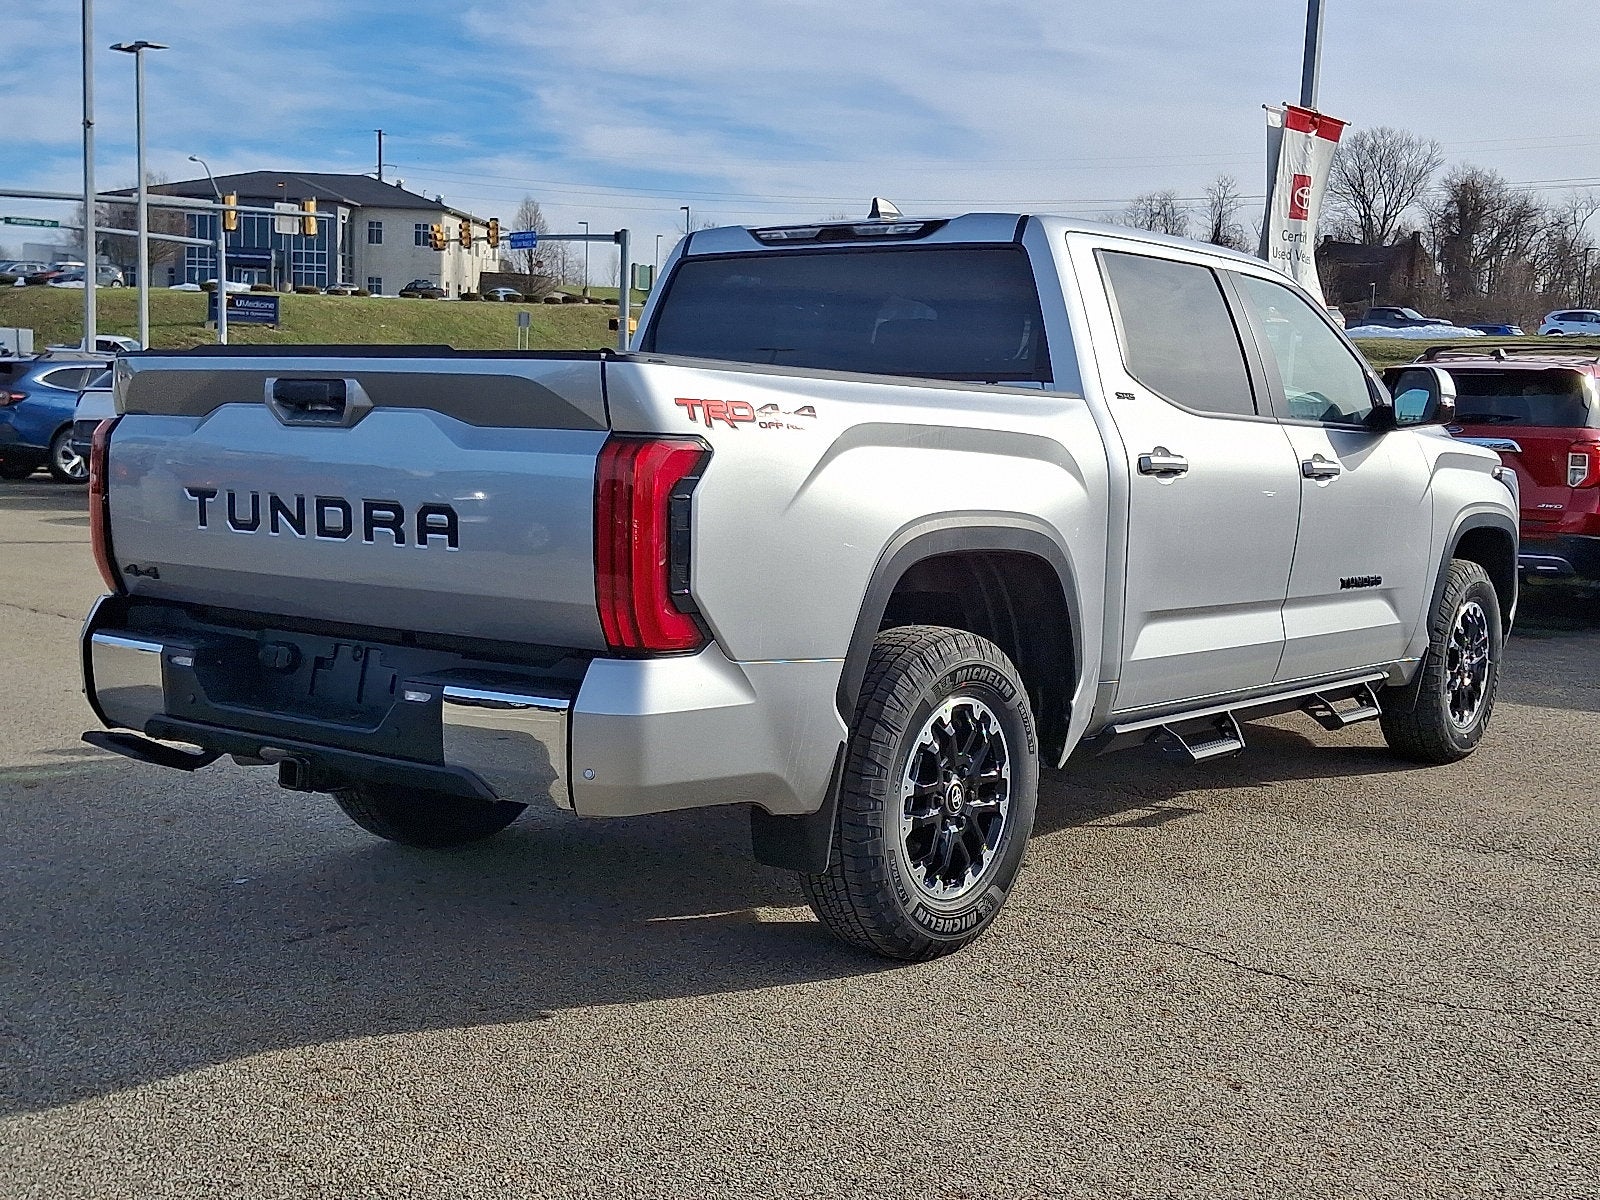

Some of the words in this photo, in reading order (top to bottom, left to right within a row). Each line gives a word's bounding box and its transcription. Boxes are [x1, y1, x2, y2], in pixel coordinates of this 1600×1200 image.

[1272, 246, 1292, 260] Used
[674, 397, 756, 430] TRD
[183, 486, 461, 552] TUNDRA
[123, 563, 161, 580] 4x4
[955, 666, 1014, 698] MICHELIN
[914, 907, 978, 933] MICHELIN
